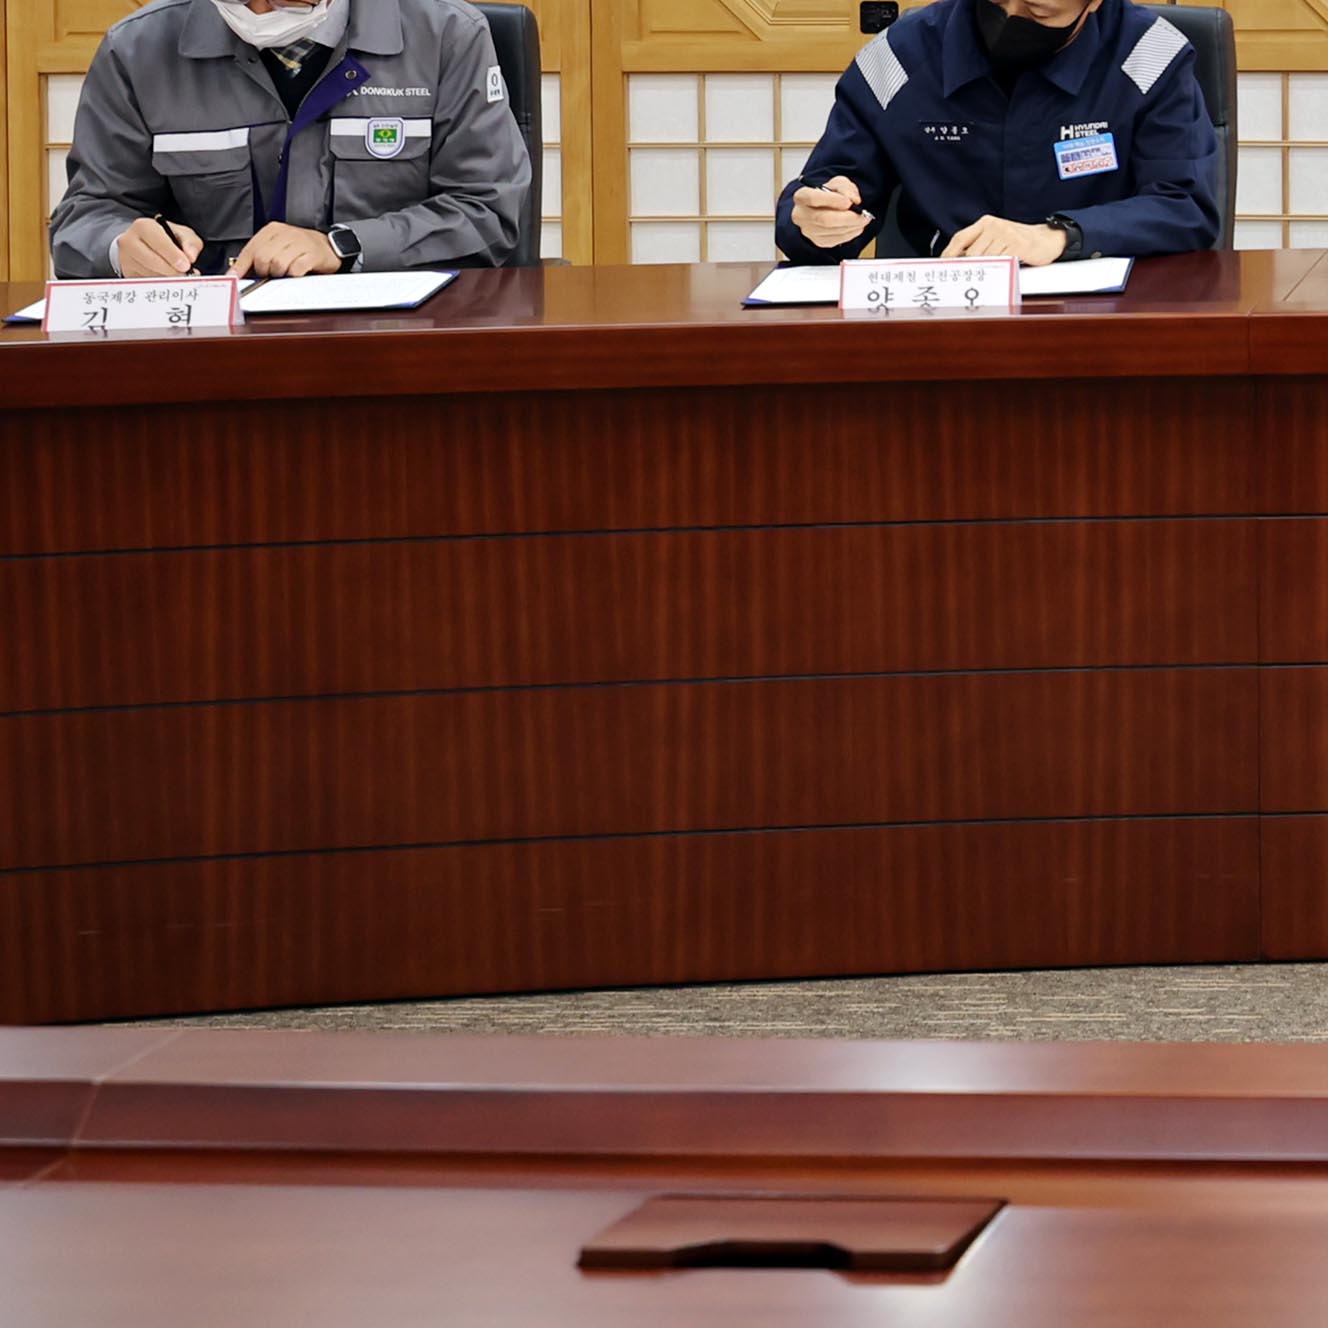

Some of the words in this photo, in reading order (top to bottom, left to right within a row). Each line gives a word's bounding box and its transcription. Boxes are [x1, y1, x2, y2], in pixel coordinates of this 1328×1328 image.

[360, 86, 404, 97] DONGKUK
[405, 87, 431, 97] STEEL
[82, 289, 137, 305] 동국제강
[144, 287, 199, 304] 관리이사
